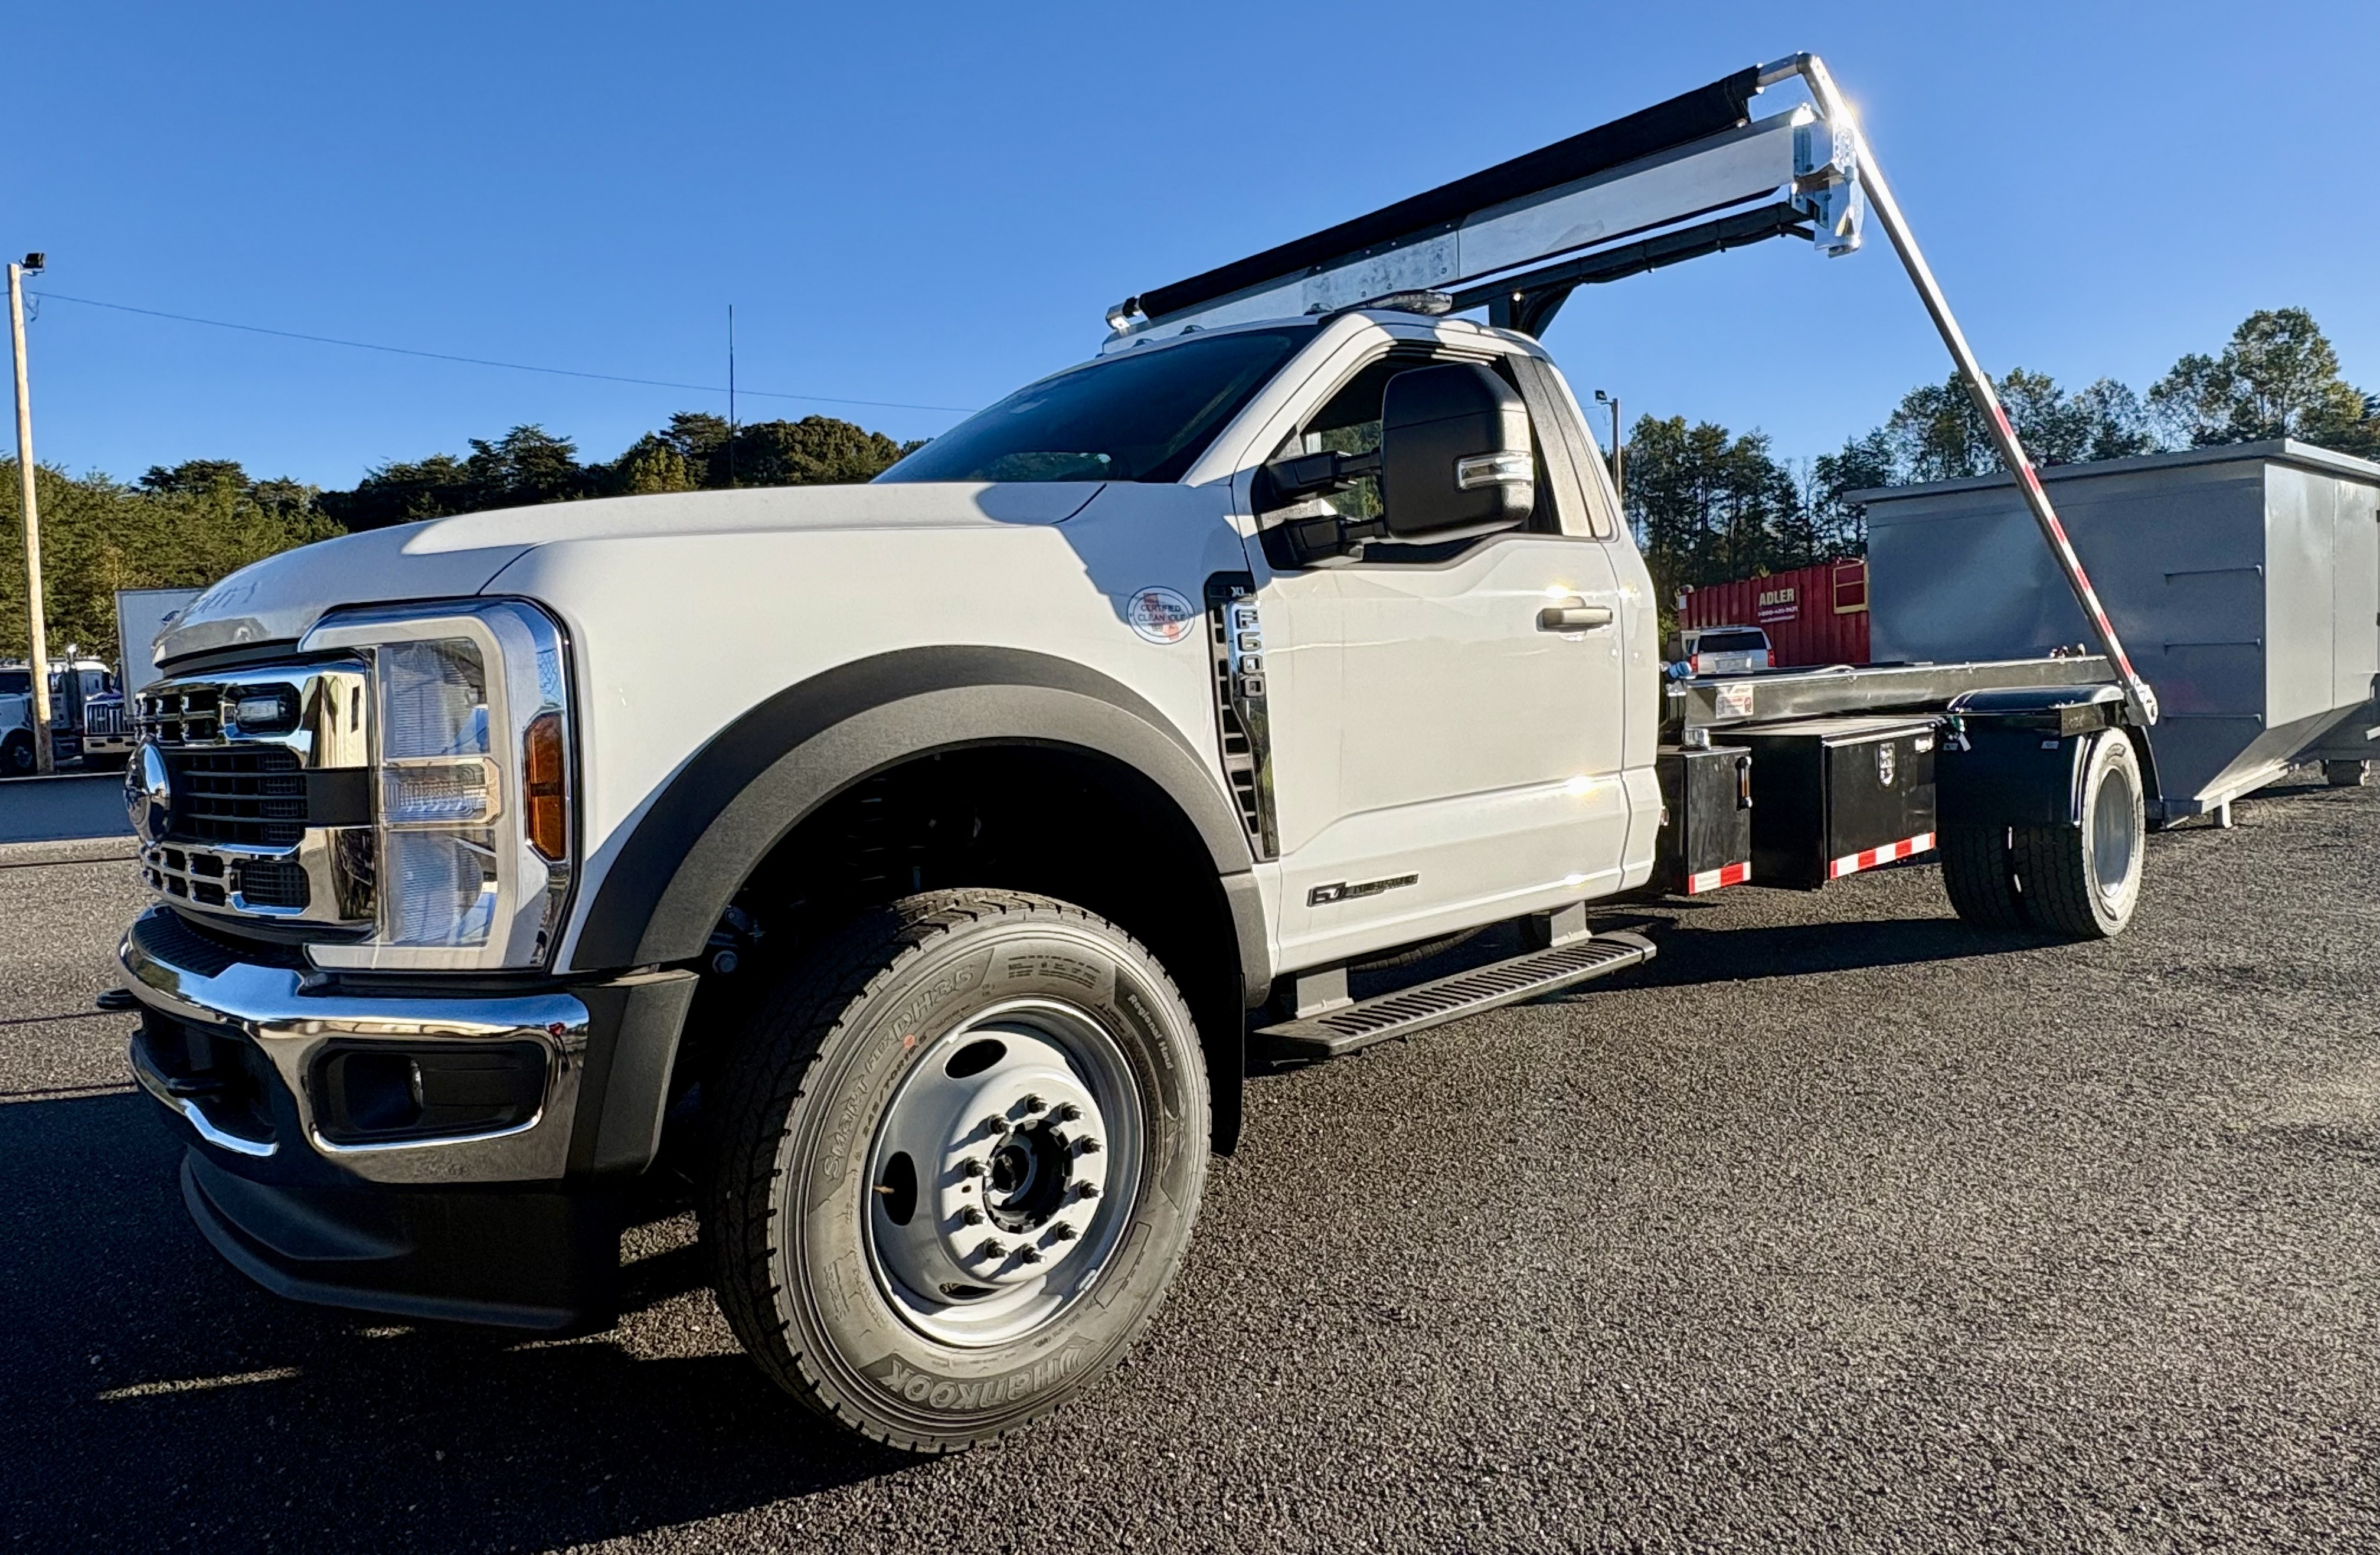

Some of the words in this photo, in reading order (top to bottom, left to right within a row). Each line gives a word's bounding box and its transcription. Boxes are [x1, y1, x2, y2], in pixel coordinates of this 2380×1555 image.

[1759, 588, 1794, 607] ADLER
[1140, 604, 1181, 612] CERTIFIED
[1137, 613, 1165, 622] CLEAN
[1127, 994, 1165, 1041] Regional
[1158, 1041, 1174, 1070] Haul
